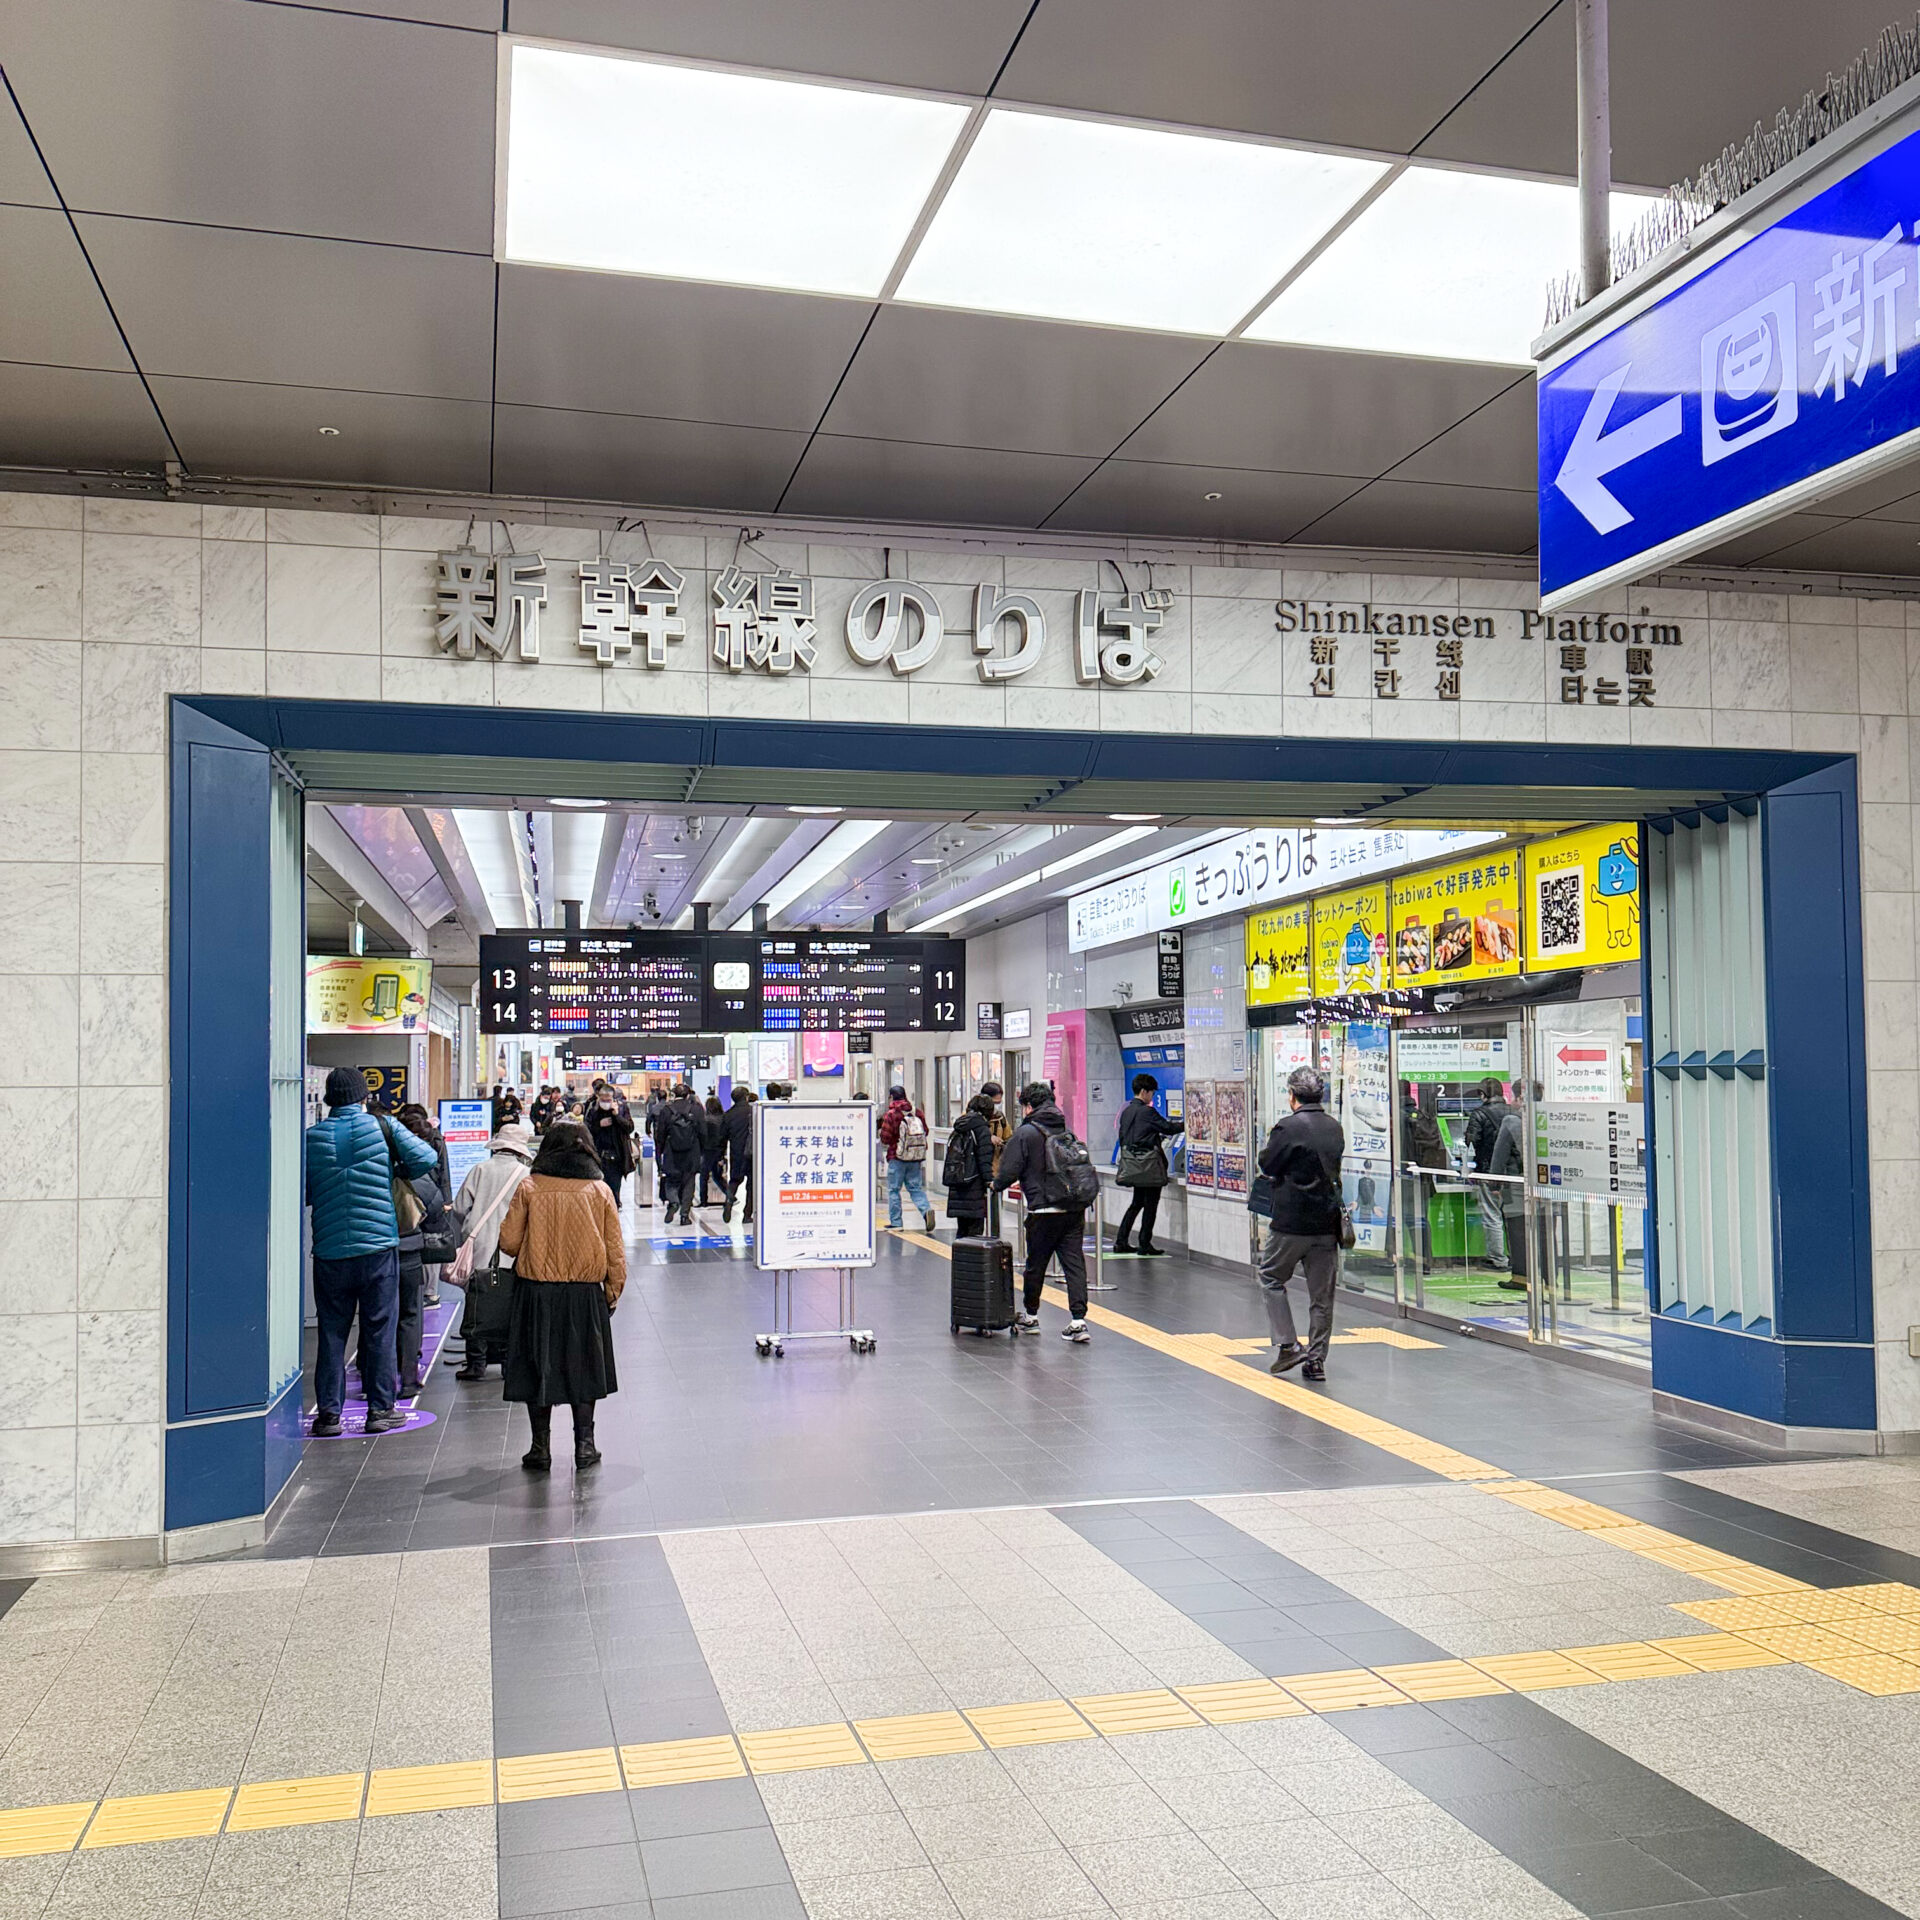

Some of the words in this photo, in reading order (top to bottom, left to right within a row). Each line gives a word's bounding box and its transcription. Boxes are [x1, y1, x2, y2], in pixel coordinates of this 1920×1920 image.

[1813, 218, 1920, 403] 新
[434, 545, 1176, 682] 新幹線のりば
[1275, 600, 1496, 640] Shinkansen
[1521, 605, 1684, 647] Platform
[1310, 668, 1462, 700] 신칸센
[1561, 675, 1656, 708] 타는곳
[1538, 849, 1580, 869] 購入はこちら
[492, 969, 517, 989] 13
[935, 971, 953, 989] 11
[492, 1002, 518, 1023] 14
[934, 1002, 956, 1021] 12
[564, 1050, 574, 1059] 13
[1436, 1084, 1446, 1097] 2
[1156, 1094, 1162, 1108] 3
[779, 1135, 854, 1149] 年末年始は
[789, 1151, 844, 1168] 「のぞみ」
[779, 1170, 855, 1185] 全席指定席
[1358, 1229, 1373, 1242] JR
